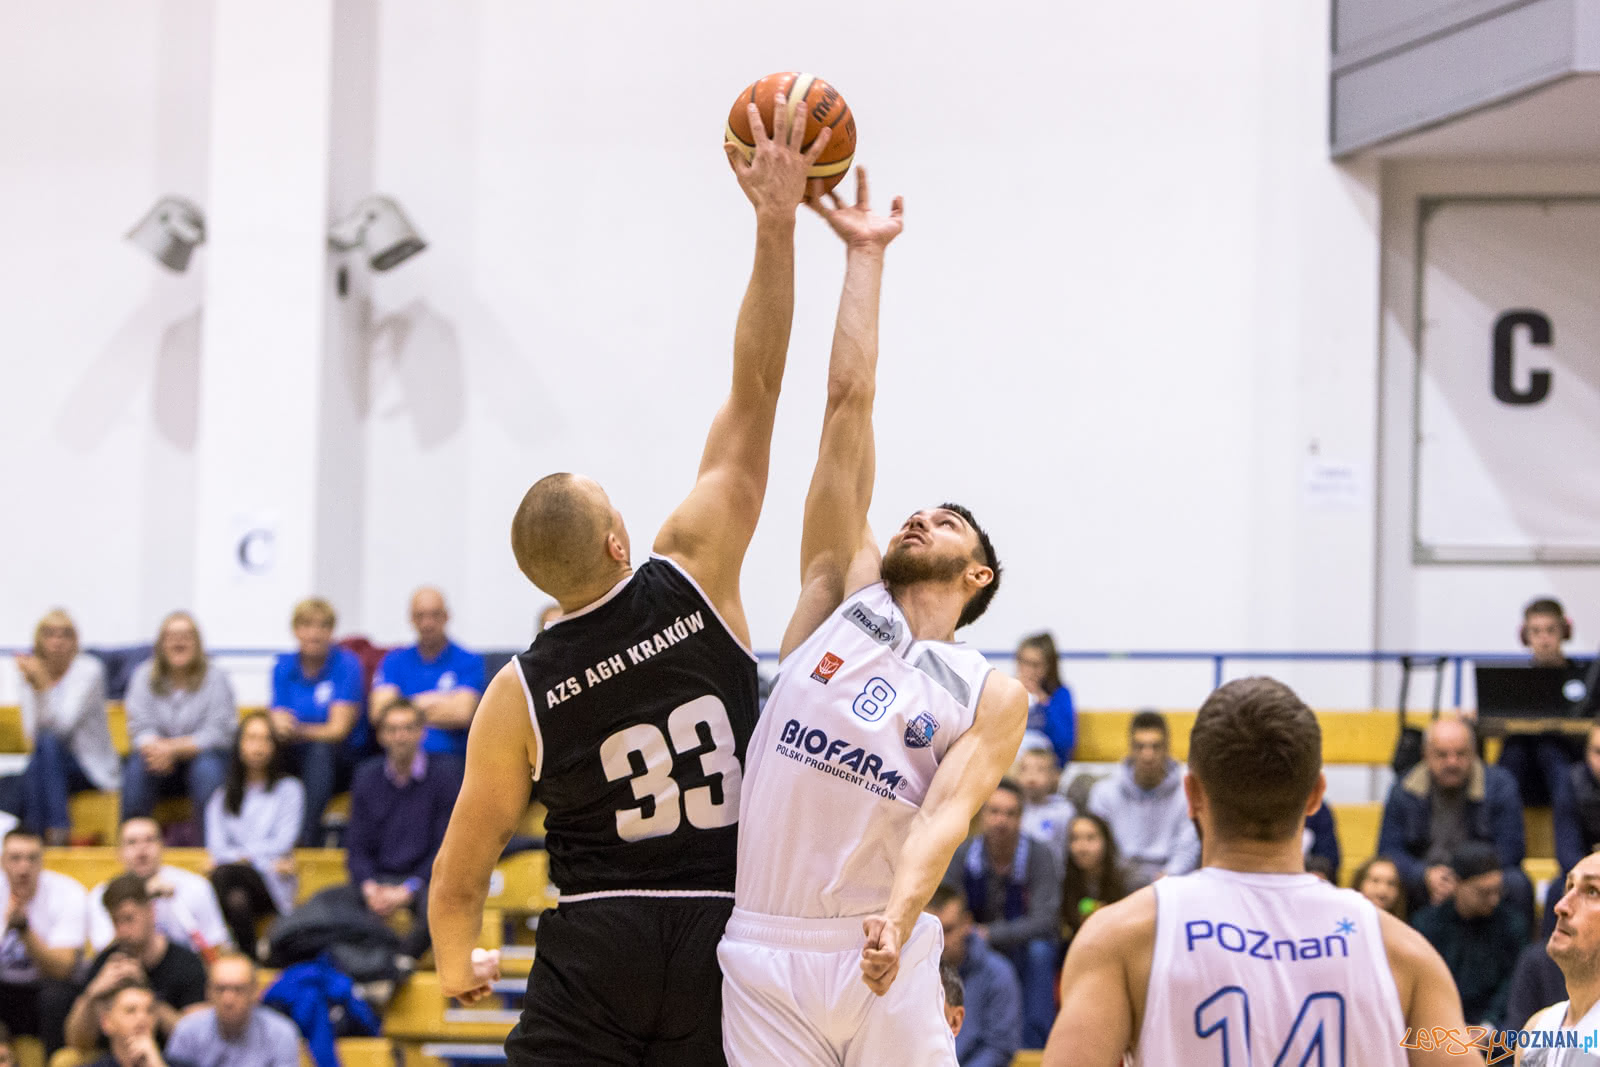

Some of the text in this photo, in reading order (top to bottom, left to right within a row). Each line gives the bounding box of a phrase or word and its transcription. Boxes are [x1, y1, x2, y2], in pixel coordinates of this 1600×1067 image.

[1491, 308, 1553, 406] C
[235, 529, 276, 575] C
[545, 610, 706, 710] AZS AGH KRAKÓW
[852, 676, 897, 722] 8
[599, 694, 743, 843] 33
[775, 743, 898, 802] POLSKI PRODUCENT LEKÓW
[1194, 985, 1346, 1067] 14
